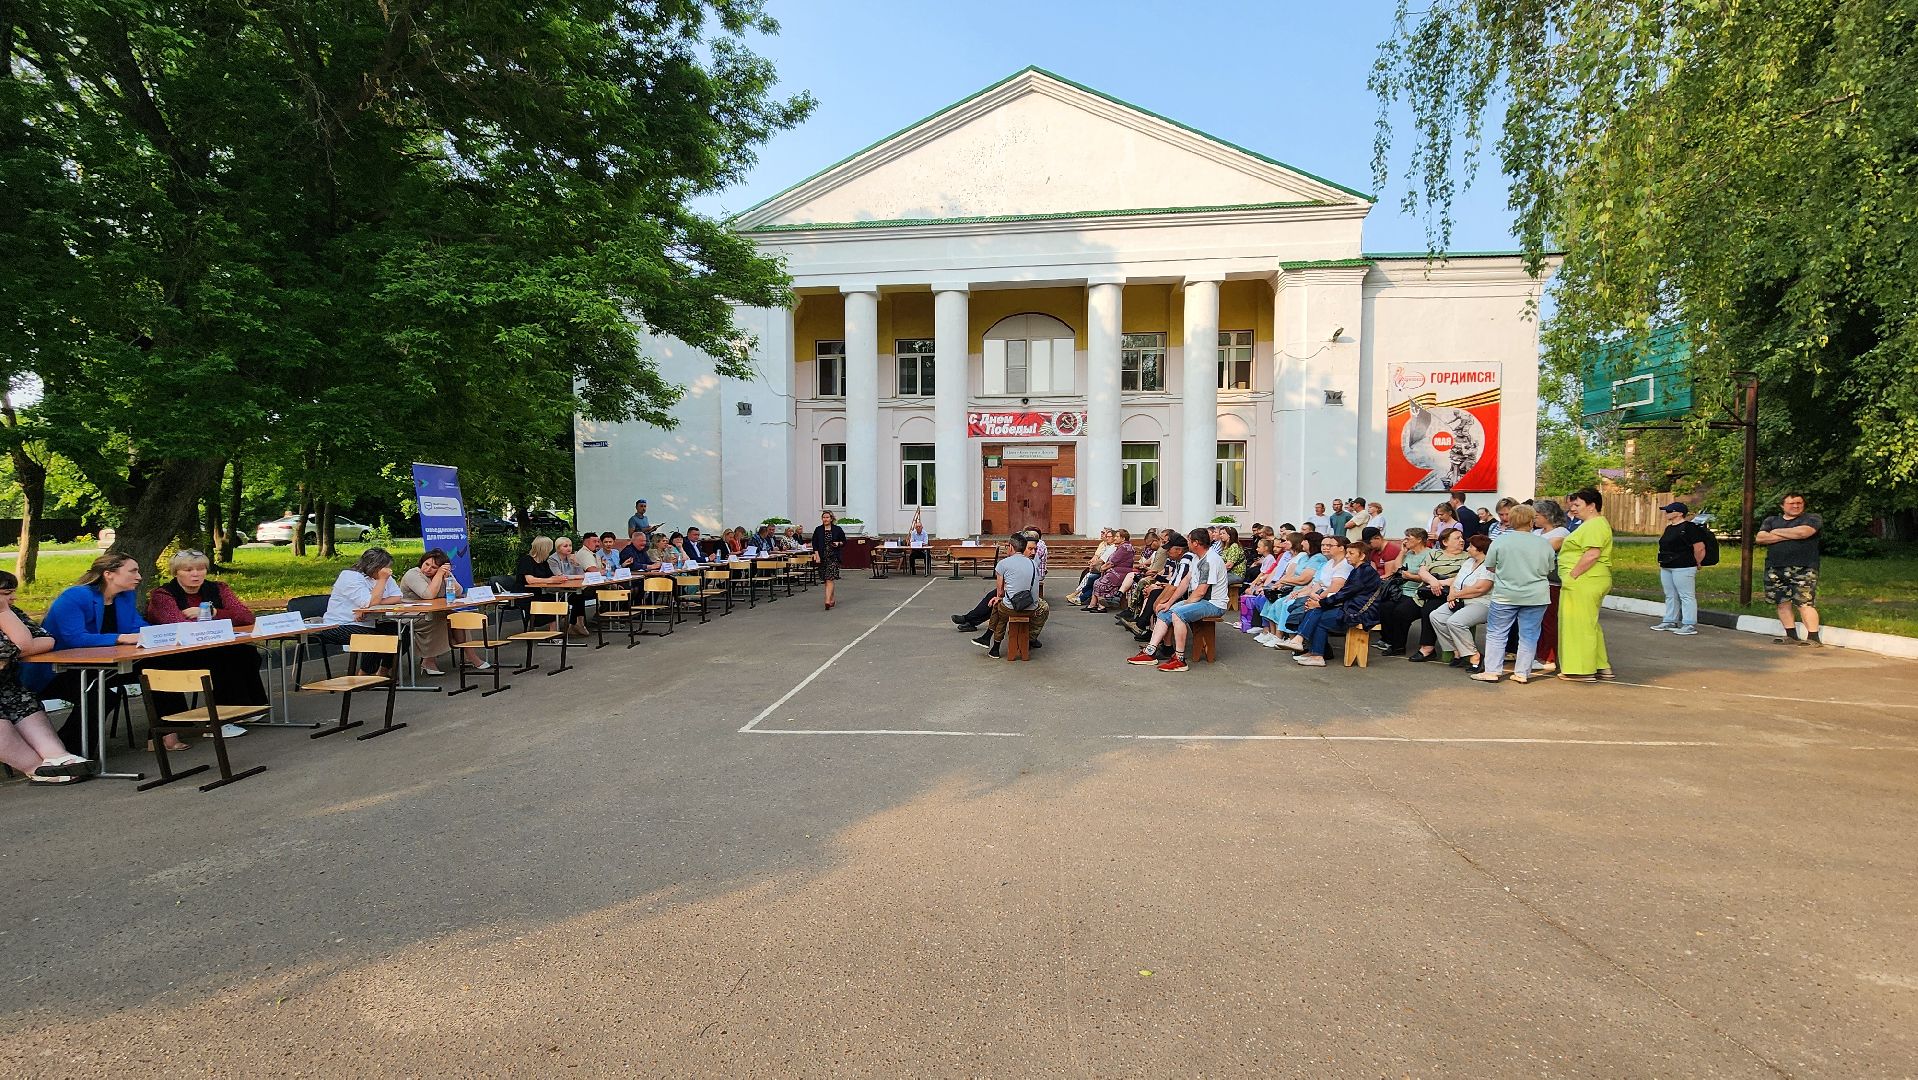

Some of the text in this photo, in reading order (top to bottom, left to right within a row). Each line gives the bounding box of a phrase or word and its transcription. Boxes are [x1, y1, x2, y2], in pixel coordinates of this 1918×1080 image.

[1430, 371, 1496, 385] ГОРДИМСЯ!
[968, 413, 1013, 425] С Днем
[985, 422, 1037, 436] Победы!
[1433, 437, 1452, 446] МАЯ
